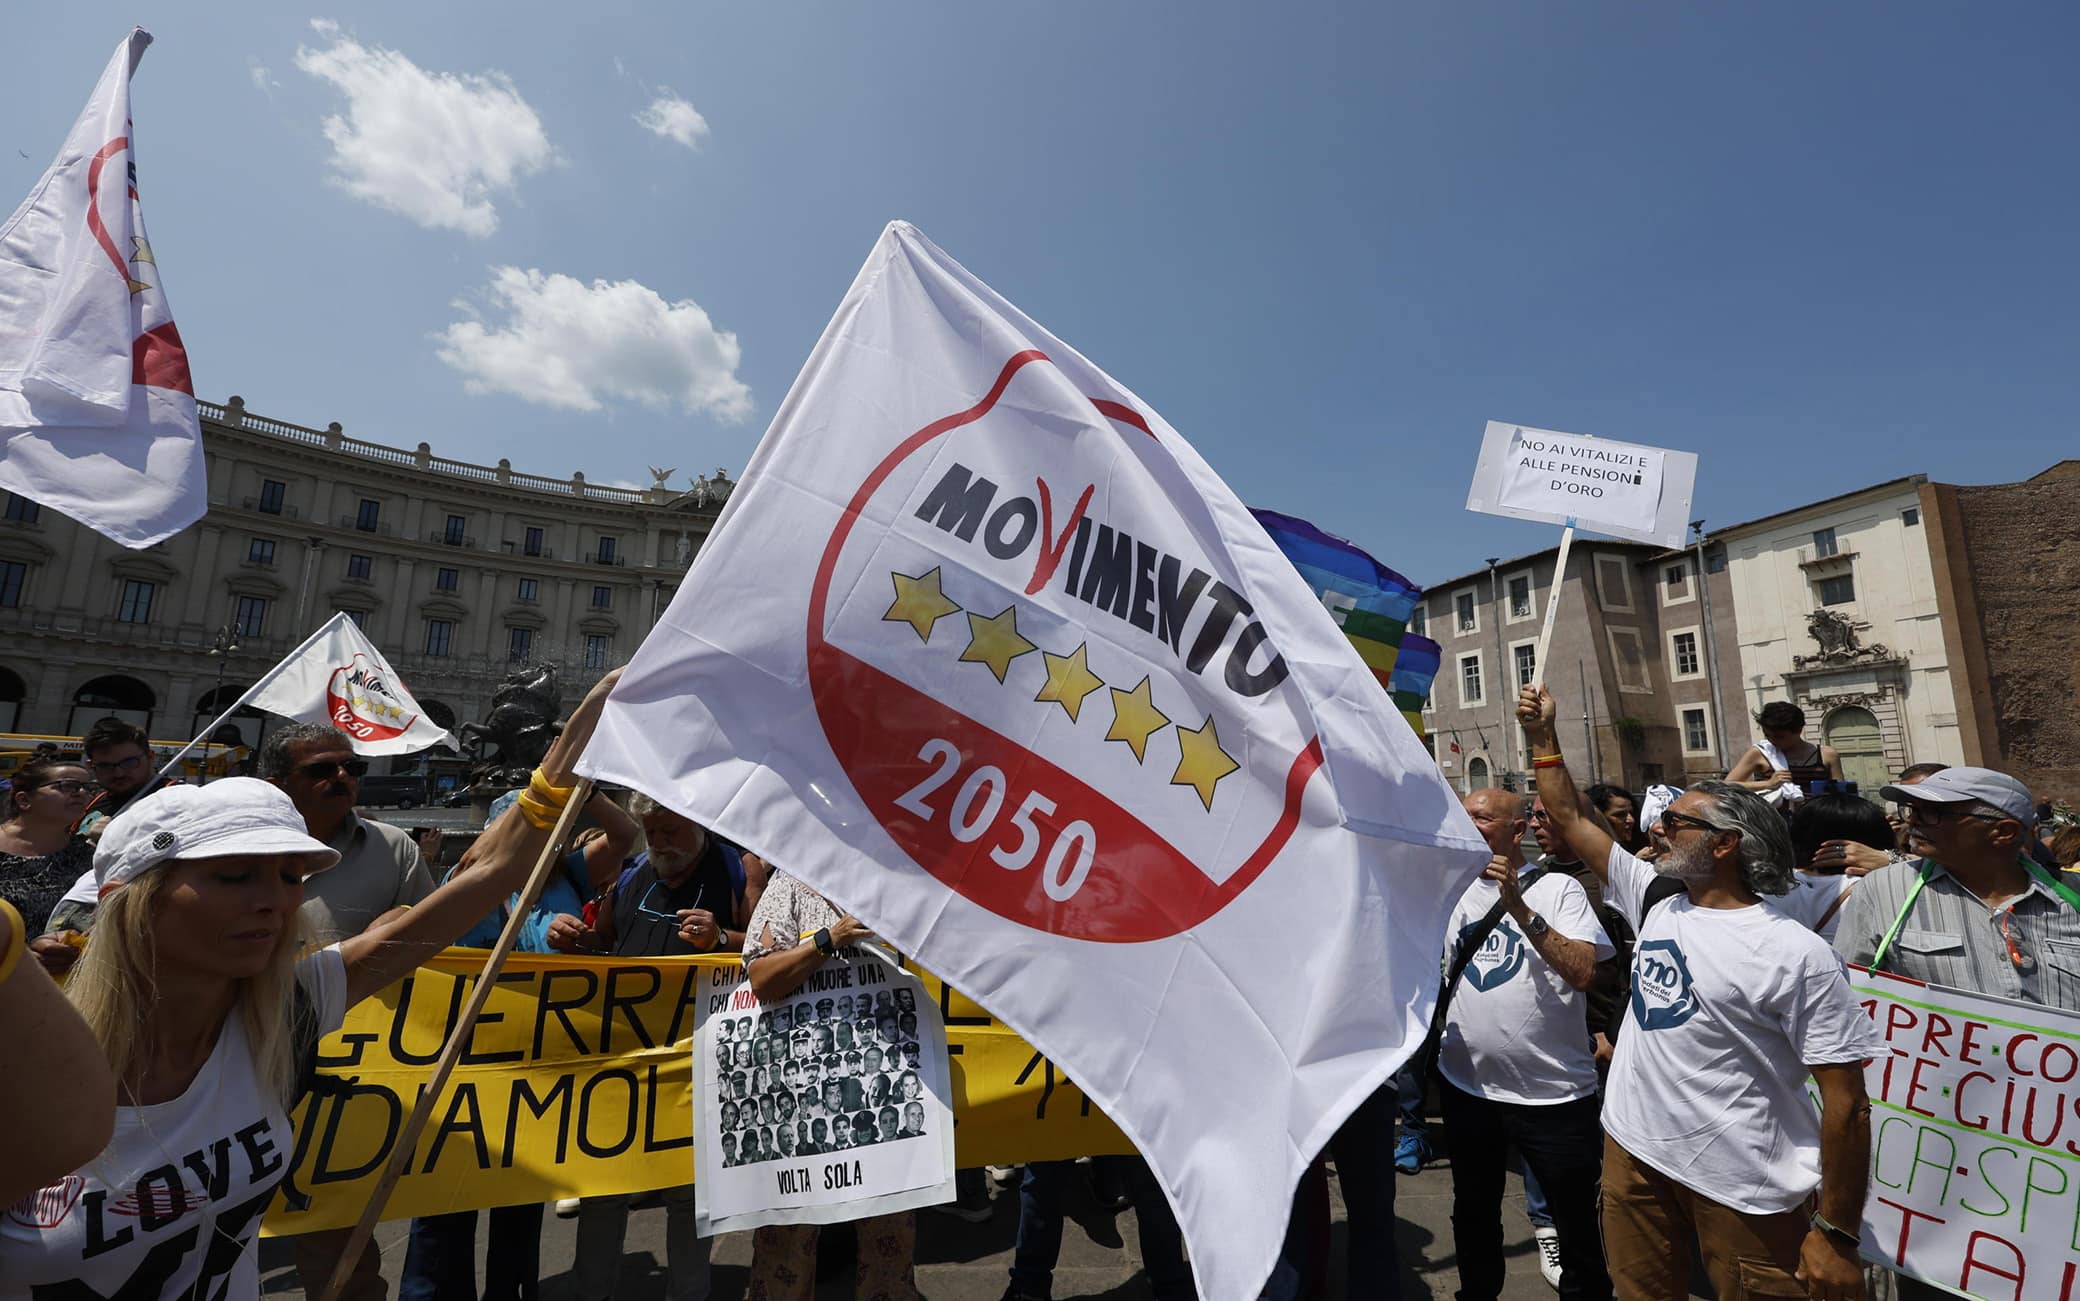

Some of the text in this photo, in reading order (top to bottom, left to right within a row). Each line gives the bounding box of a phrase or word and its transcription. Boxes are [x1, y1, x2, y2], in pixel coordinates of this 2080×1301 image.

[1520, 457, 1556, 472] ALLE
[1521, 439, 1649, 468] NO AI VITALIZI E
[914, 463, 1290, 697] MOVIMENTO
[334, 704, 374, 738] 2050
[893, 738, 1097, 902] 2050
[709, 993, 730, 1014] CHI
[731, 990, 758, 1012] NON
[808, 966, 853, 993] MUORE
[858, 963, 886, 986] UNA
[712, 965, 736, 987] CHI
[1863, 1047, 1940, 1118] TE
[82, 1117, 283, 1260] LOVE
[777, 1160, 863, 1195] VOLTA SOLA
